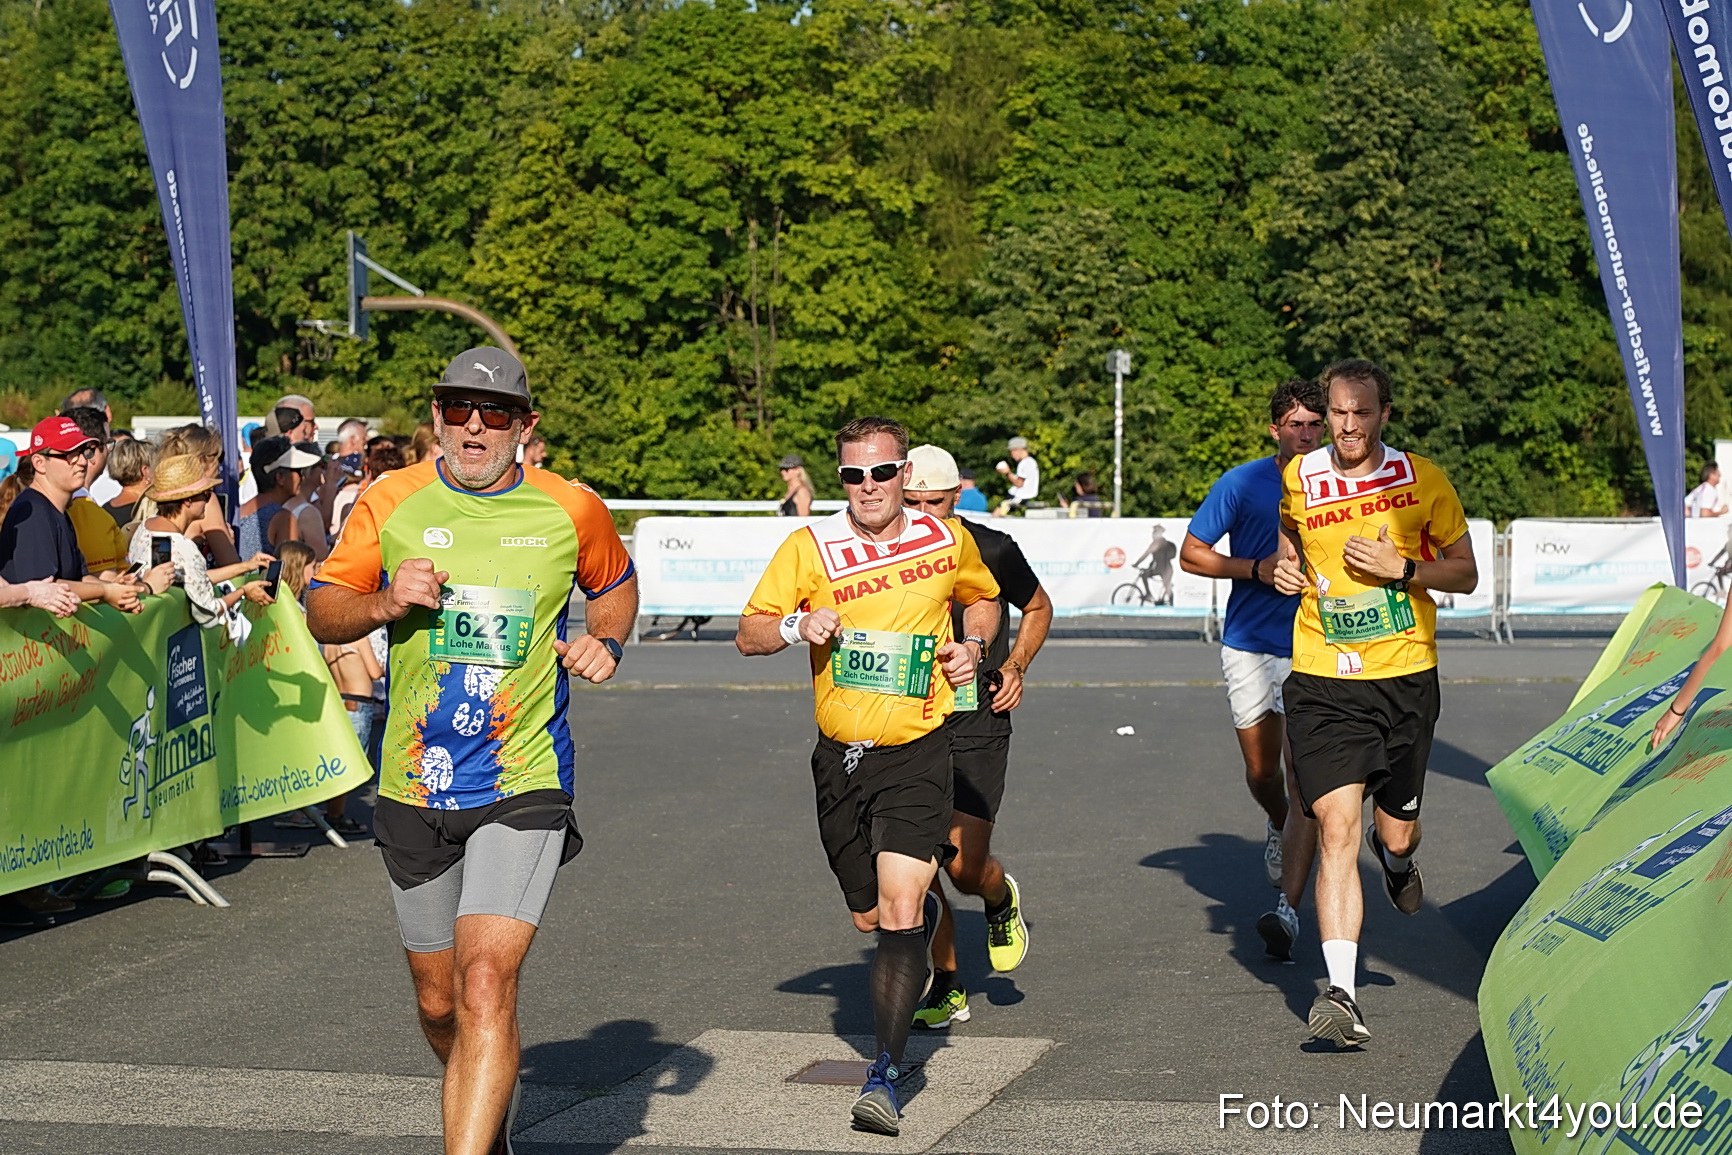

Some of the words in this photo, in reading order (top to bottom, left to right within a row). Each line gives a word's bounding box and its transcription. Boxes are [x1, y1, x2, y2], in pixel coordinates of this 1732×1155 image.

[1306, 506, 1354, 531] MAX
[1360, 491, 1420, 517] BÖGL
[502, 537, 547, 546] BOCK
[660, 538, 693, 550] NOW
[1536, 542, 1570, 554] NOW
[832, 575, 893, 605] MAX
[898, 555, 957, 585] BÖGL
[455, 611, 509, 641] 622
[1324, 616, 1335, 634] RUN
[1331, 607, 1380, 629] 1629
[1380, 605, 1392, 630] 2022
[435, 618, 446, 646] RUN
[516, 621, 529, 657] 2022
[1355, 623, 1384, 635] Andreas
[450, 639, 474, 649] Lohe
[475, 640, 511, 652] Markus
[834, 654, 843, 676] RUN
[848, 649, 890, 673] 802
[897, 657, 907, 687] 2022
[843, 670, 859, 679] Zich
[859, 672, 894, 683] Christian
[966, 684, 974, 704] 202
[153, 771, 195, 810] neumarkt
